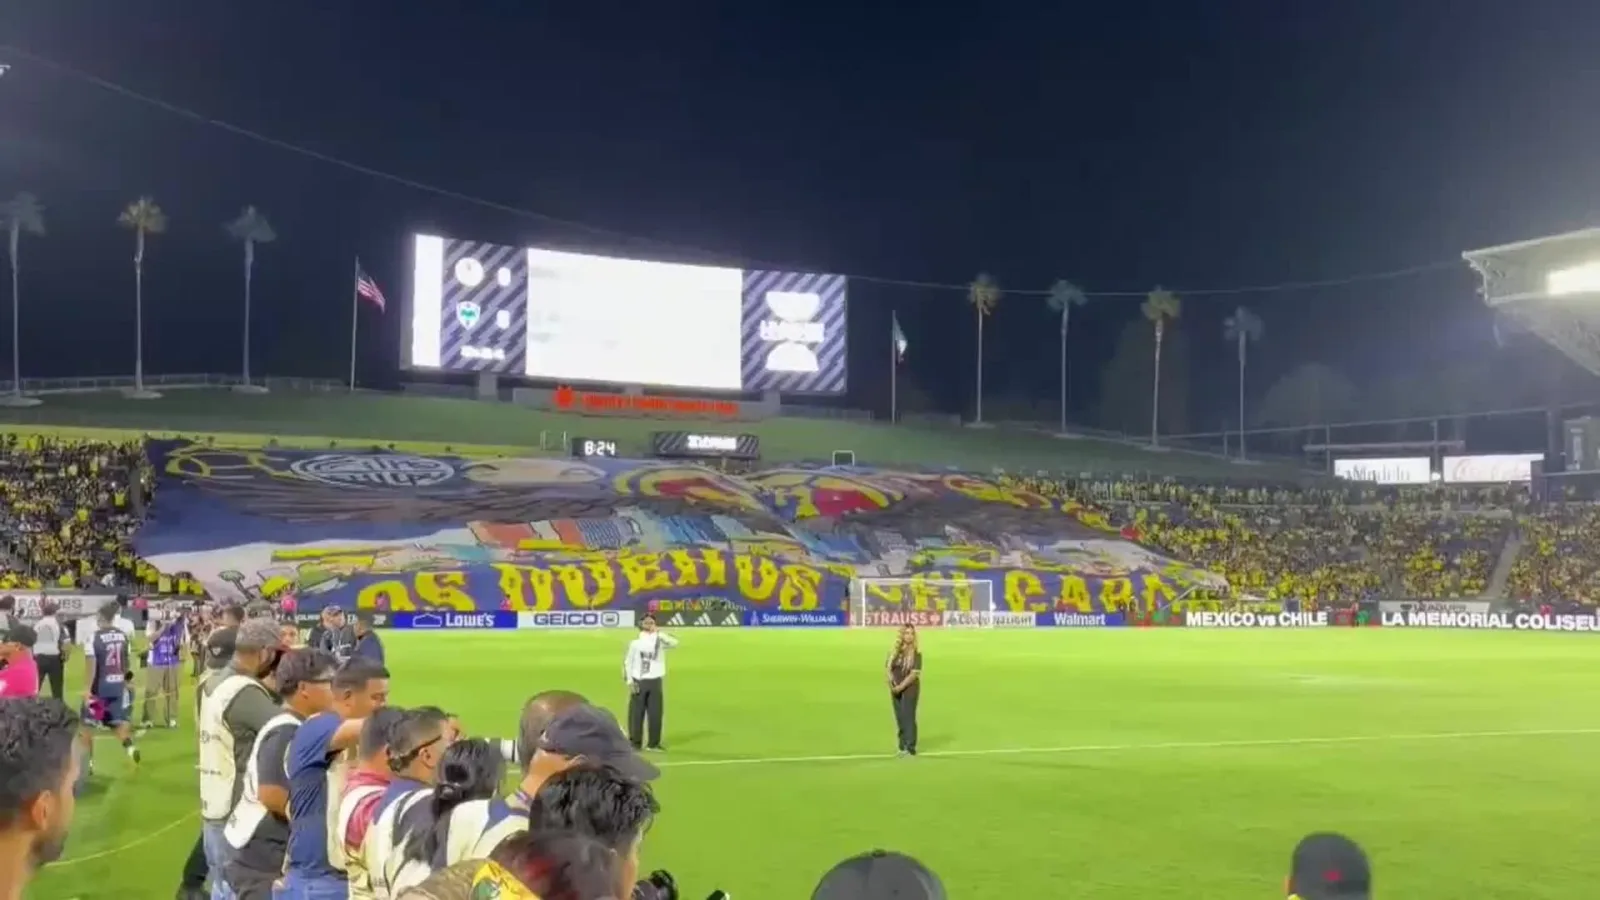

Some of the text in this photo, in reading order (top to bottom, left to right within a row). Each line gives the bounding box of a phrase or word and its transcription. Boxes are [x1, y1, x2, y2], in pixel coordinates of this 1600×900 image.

[584, 440, 616, 456] 8:24
[534, 613, 597, 625] GEICO
[1054, 612, 1106, 625] Walmart
[1186, 612, 1328, 626] MEXICO vs CHILE
[1381, 611, 1405, 626] LA
[1408, 611, 1513, 628] MEMORIAL
